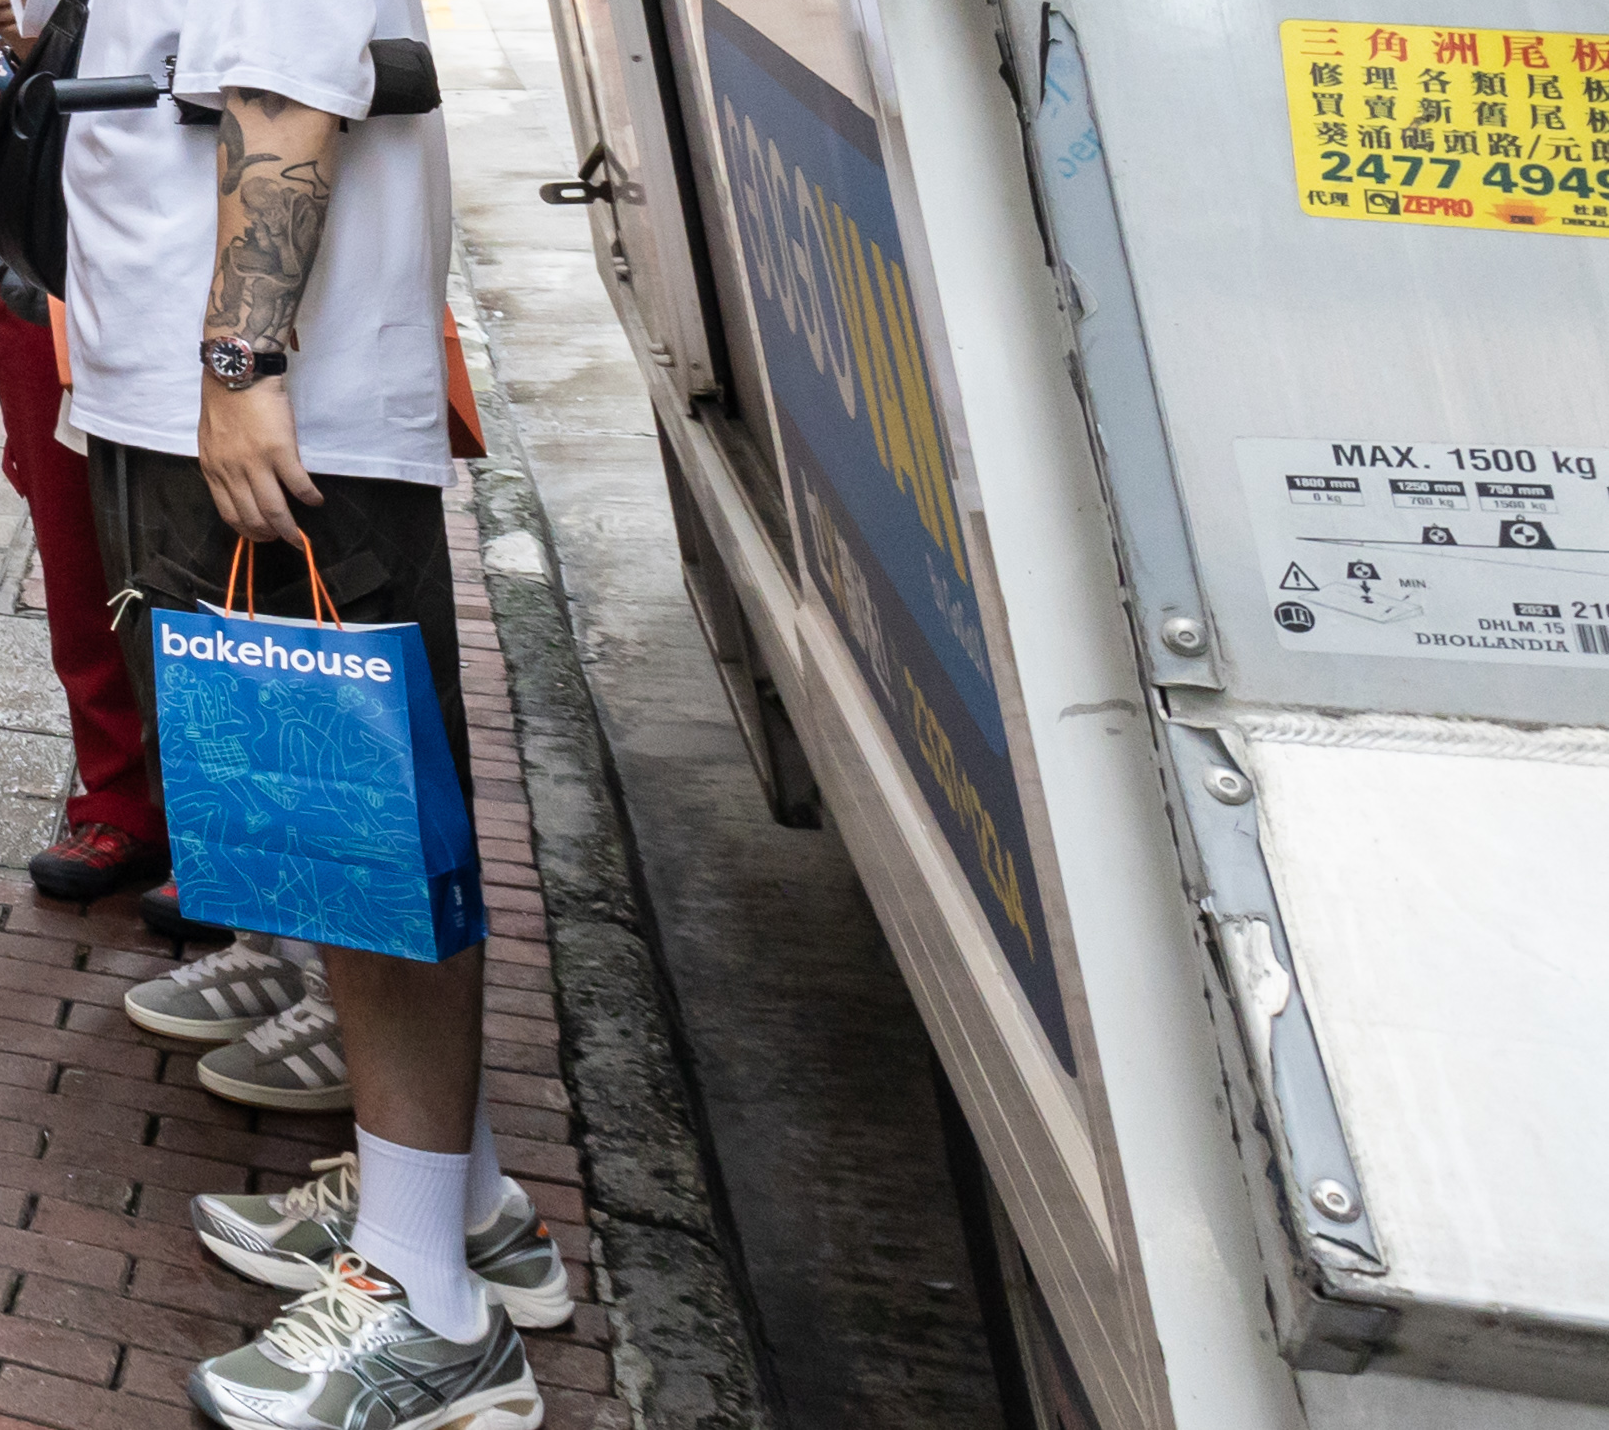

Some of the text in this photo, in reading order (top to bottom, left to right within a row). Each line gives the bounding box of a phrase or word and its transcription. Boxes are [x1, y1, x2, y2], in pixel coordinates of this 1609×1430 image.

[1300, 26, 1609, 73] 三角洲尾板
[1309, 62, 1609, 104] 修理各類尾板
[1320, 150, 1461, 190] 2477
[1306, 189, 1351, 208] 代理
[1402, 194, 1474, 218] ZEPRO
[721, 92, 969, 587] GOGOVAN
[1331, 443, 1599, 480] MAX. 1500 kg
[1326, 492, 1343, 505] kg
[1439, 497, 1455, 509] kg
[1329, 479, 1357, 490] mm
[1433, 483, 1462, 494] mm
[1517, 486, 1547, 497] mm
[1478, 618, 1566, 635] DHLM.15
[161, 624, 392, 682] bakehouse
[1414, 632, 1571, 653] DHOLLANDIA
